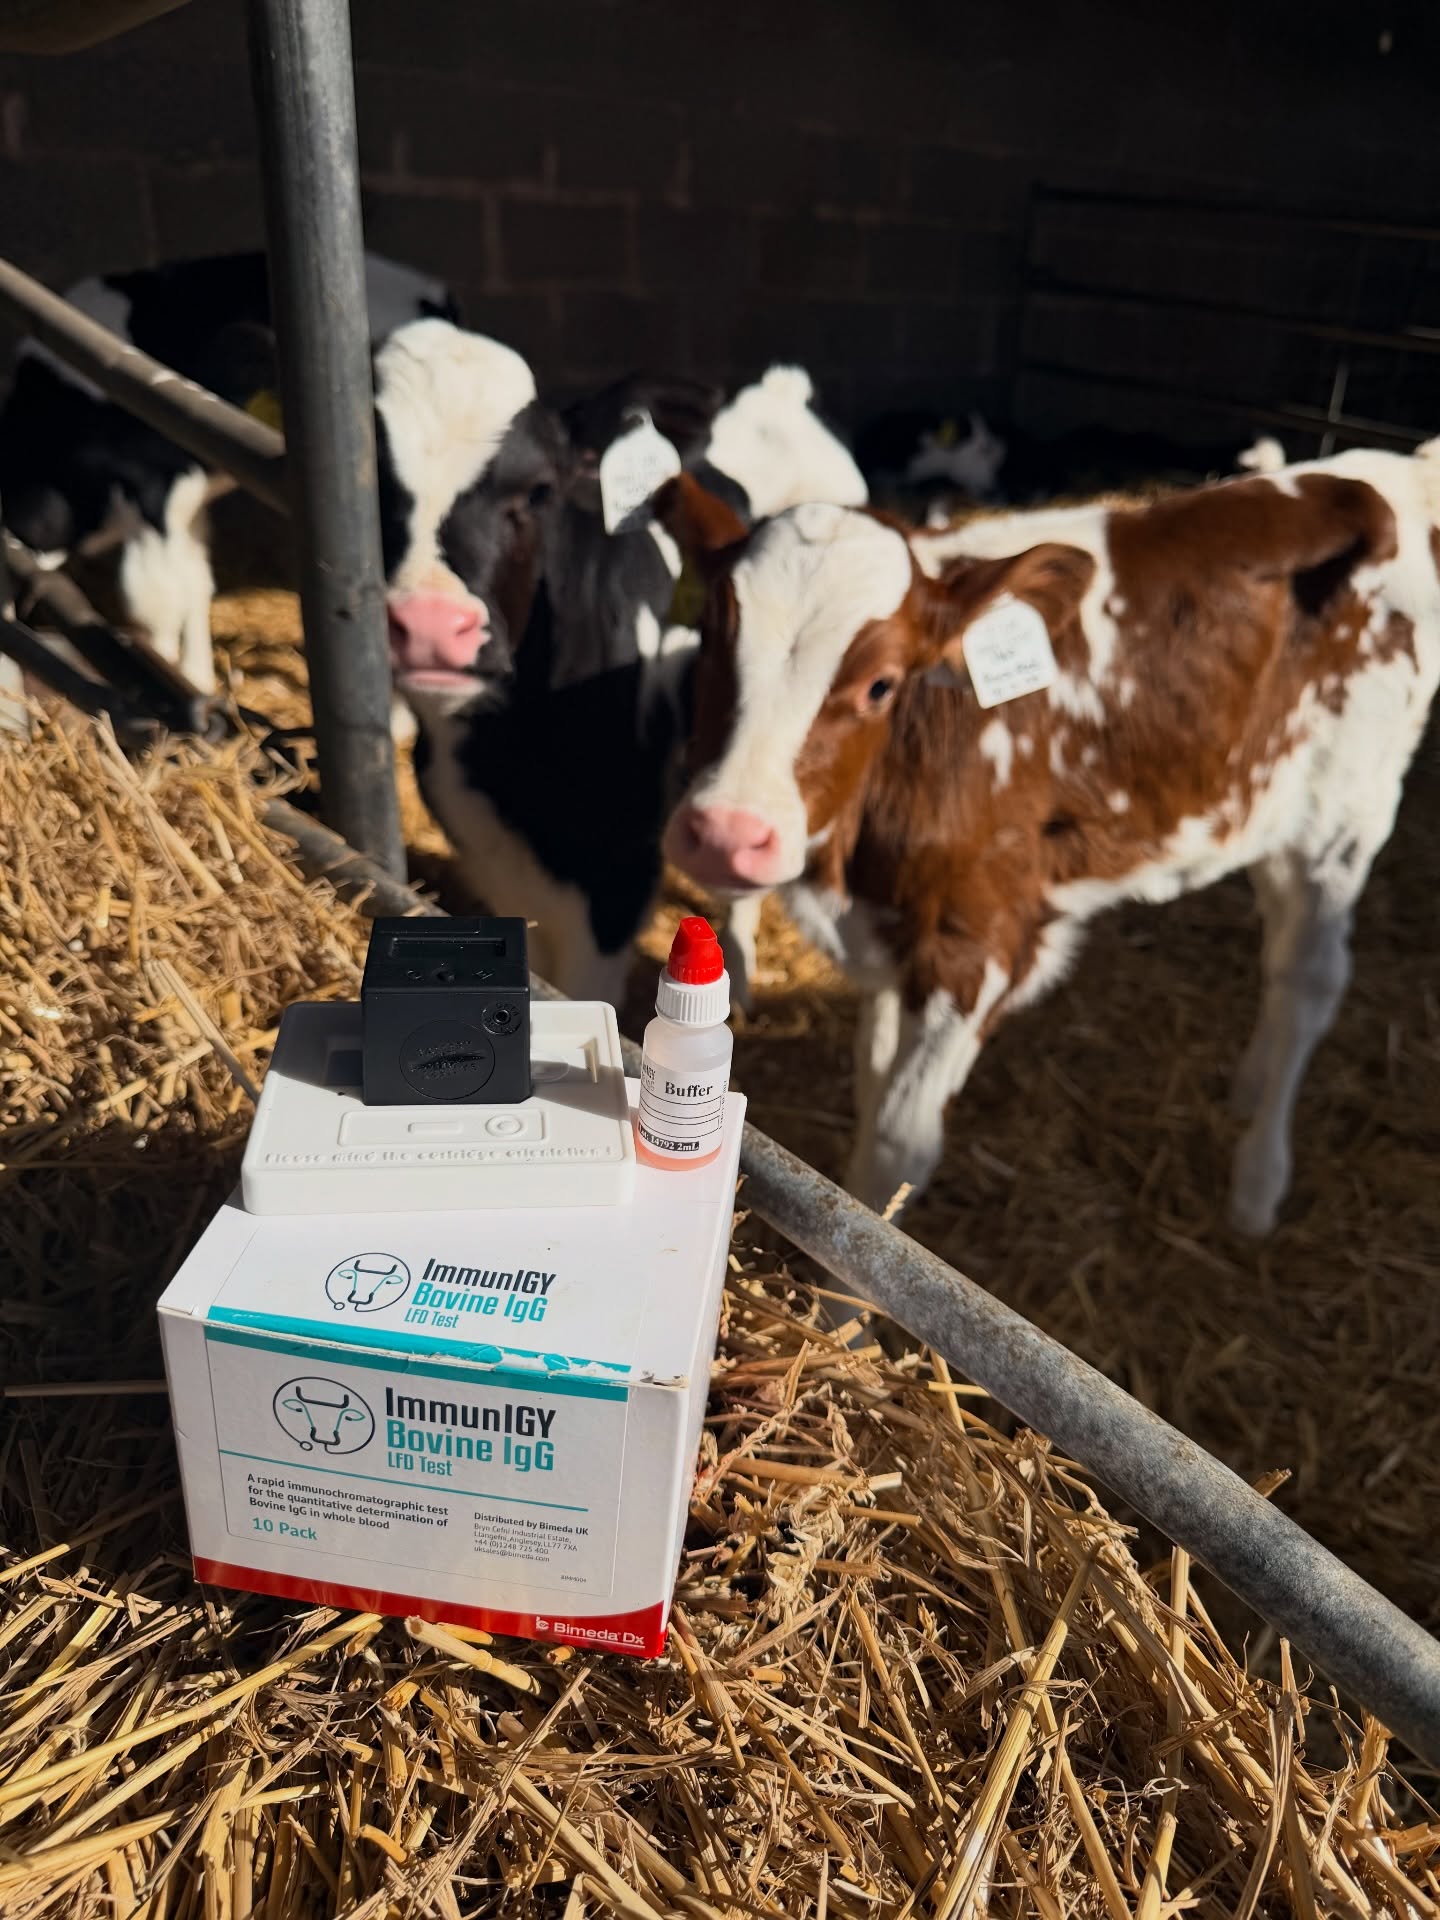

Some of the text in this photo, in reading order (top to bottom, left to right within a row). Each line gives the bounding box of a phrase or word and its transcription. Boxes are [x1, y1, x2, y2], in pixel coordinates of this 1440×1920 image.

[665, 1081, 713, 1097] Buffer
[650, 1136, 675, 1150] 14792
[677, 1142, 699, 1151] 2mL
[422, 1258, 556, 1295] ImmunIGY
[411, 1282, 551, 1323] Bovine IgG
[404, 1308, 460, 1329] LFD Test
[385, 1387, 557, 1439] ImmunIGY
[387, 1420, 555, 1472] Bovine IgG
[388, 1452, 453, 1477] LFD Test
[247, 1474, 449, 1516] A rapid immunochromatographic test
[248, 1485, 449, 1527] for the quantitative determination of
[249, 1497, 390, 1529] Bovine IgG in whole blood
[474, 1512, 589, 1536] Distributed by Bimeda UK
[253, 1517, 317, 1540] 10 Pack
[512, 1528, 545, 1540] Industrial
[519, 1545, 533, 1553] 725
[534, 1547, 549, 1555] 400
[622, 1632, 645, 1645] Dx
